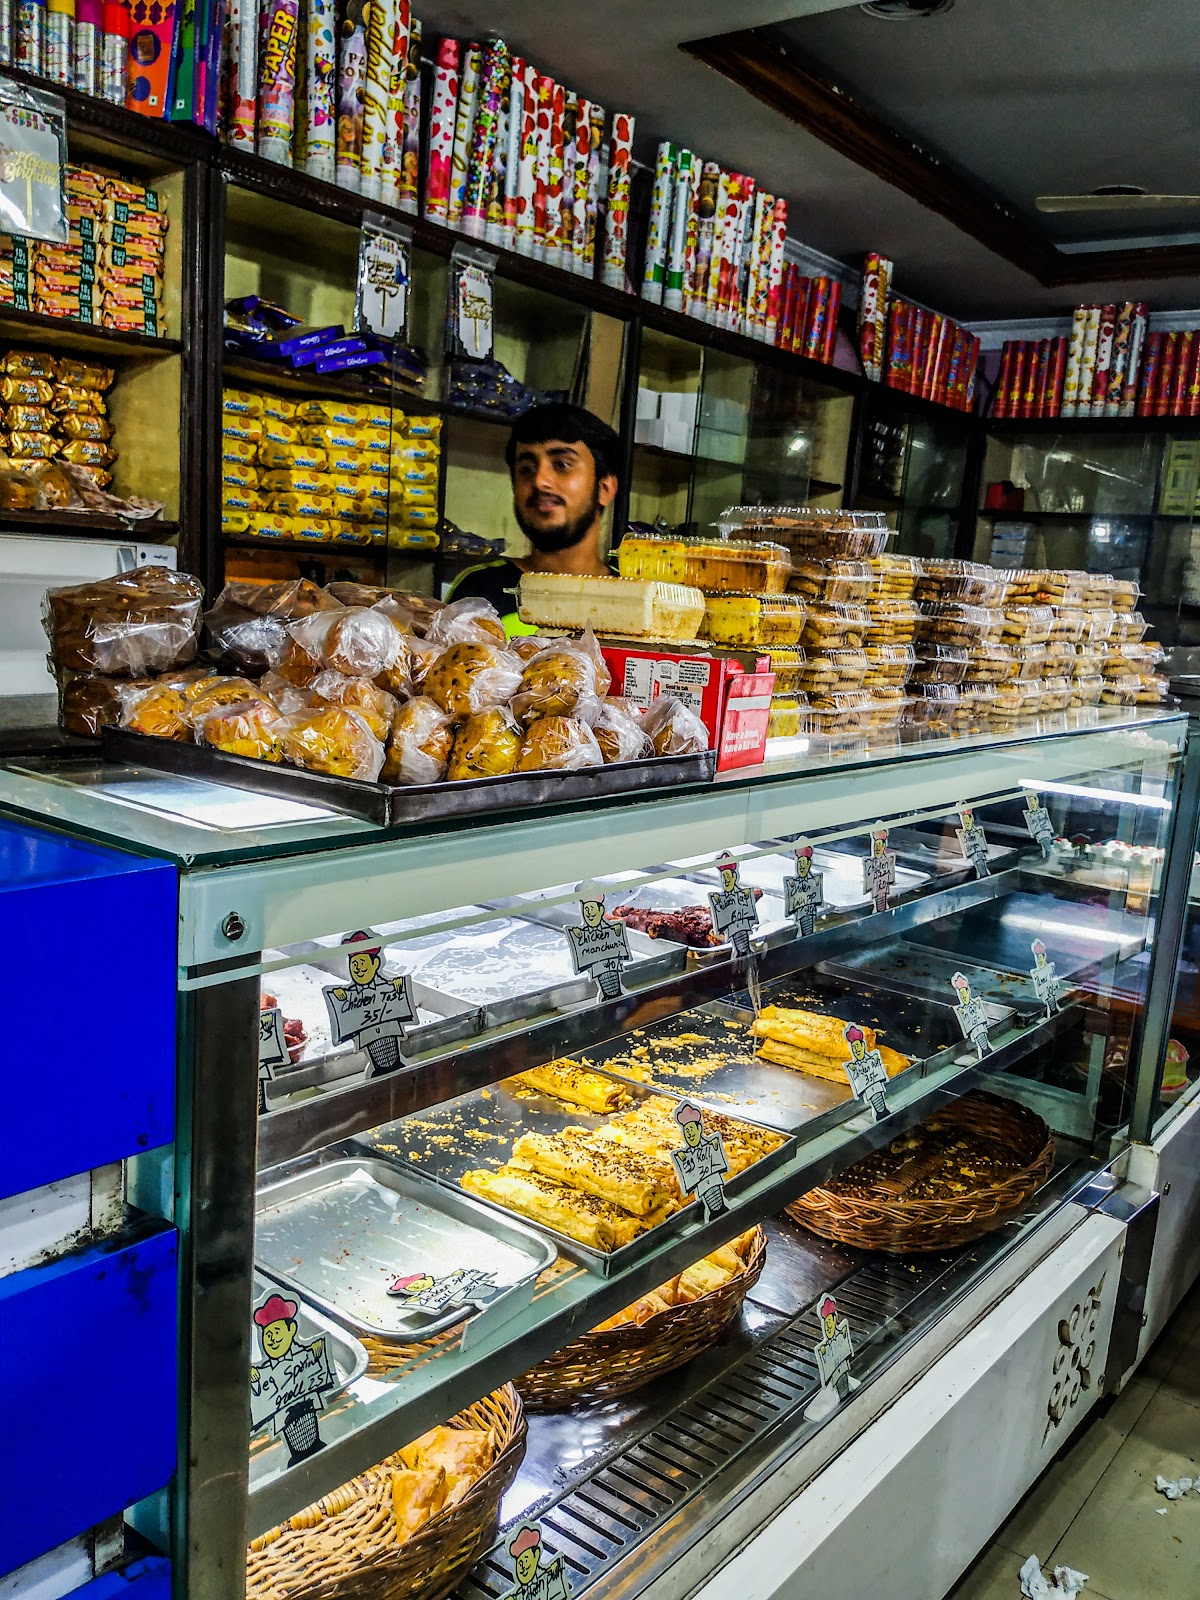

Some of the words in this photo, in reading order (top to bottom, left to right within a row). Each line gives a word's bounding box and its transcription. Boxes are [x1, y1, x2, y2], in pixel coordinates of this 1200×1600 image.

[263, 10, 295, 85] PAPER
[341, 991, 376, 1014] Chicken
[251, 1376, 279, 1402] Veg
